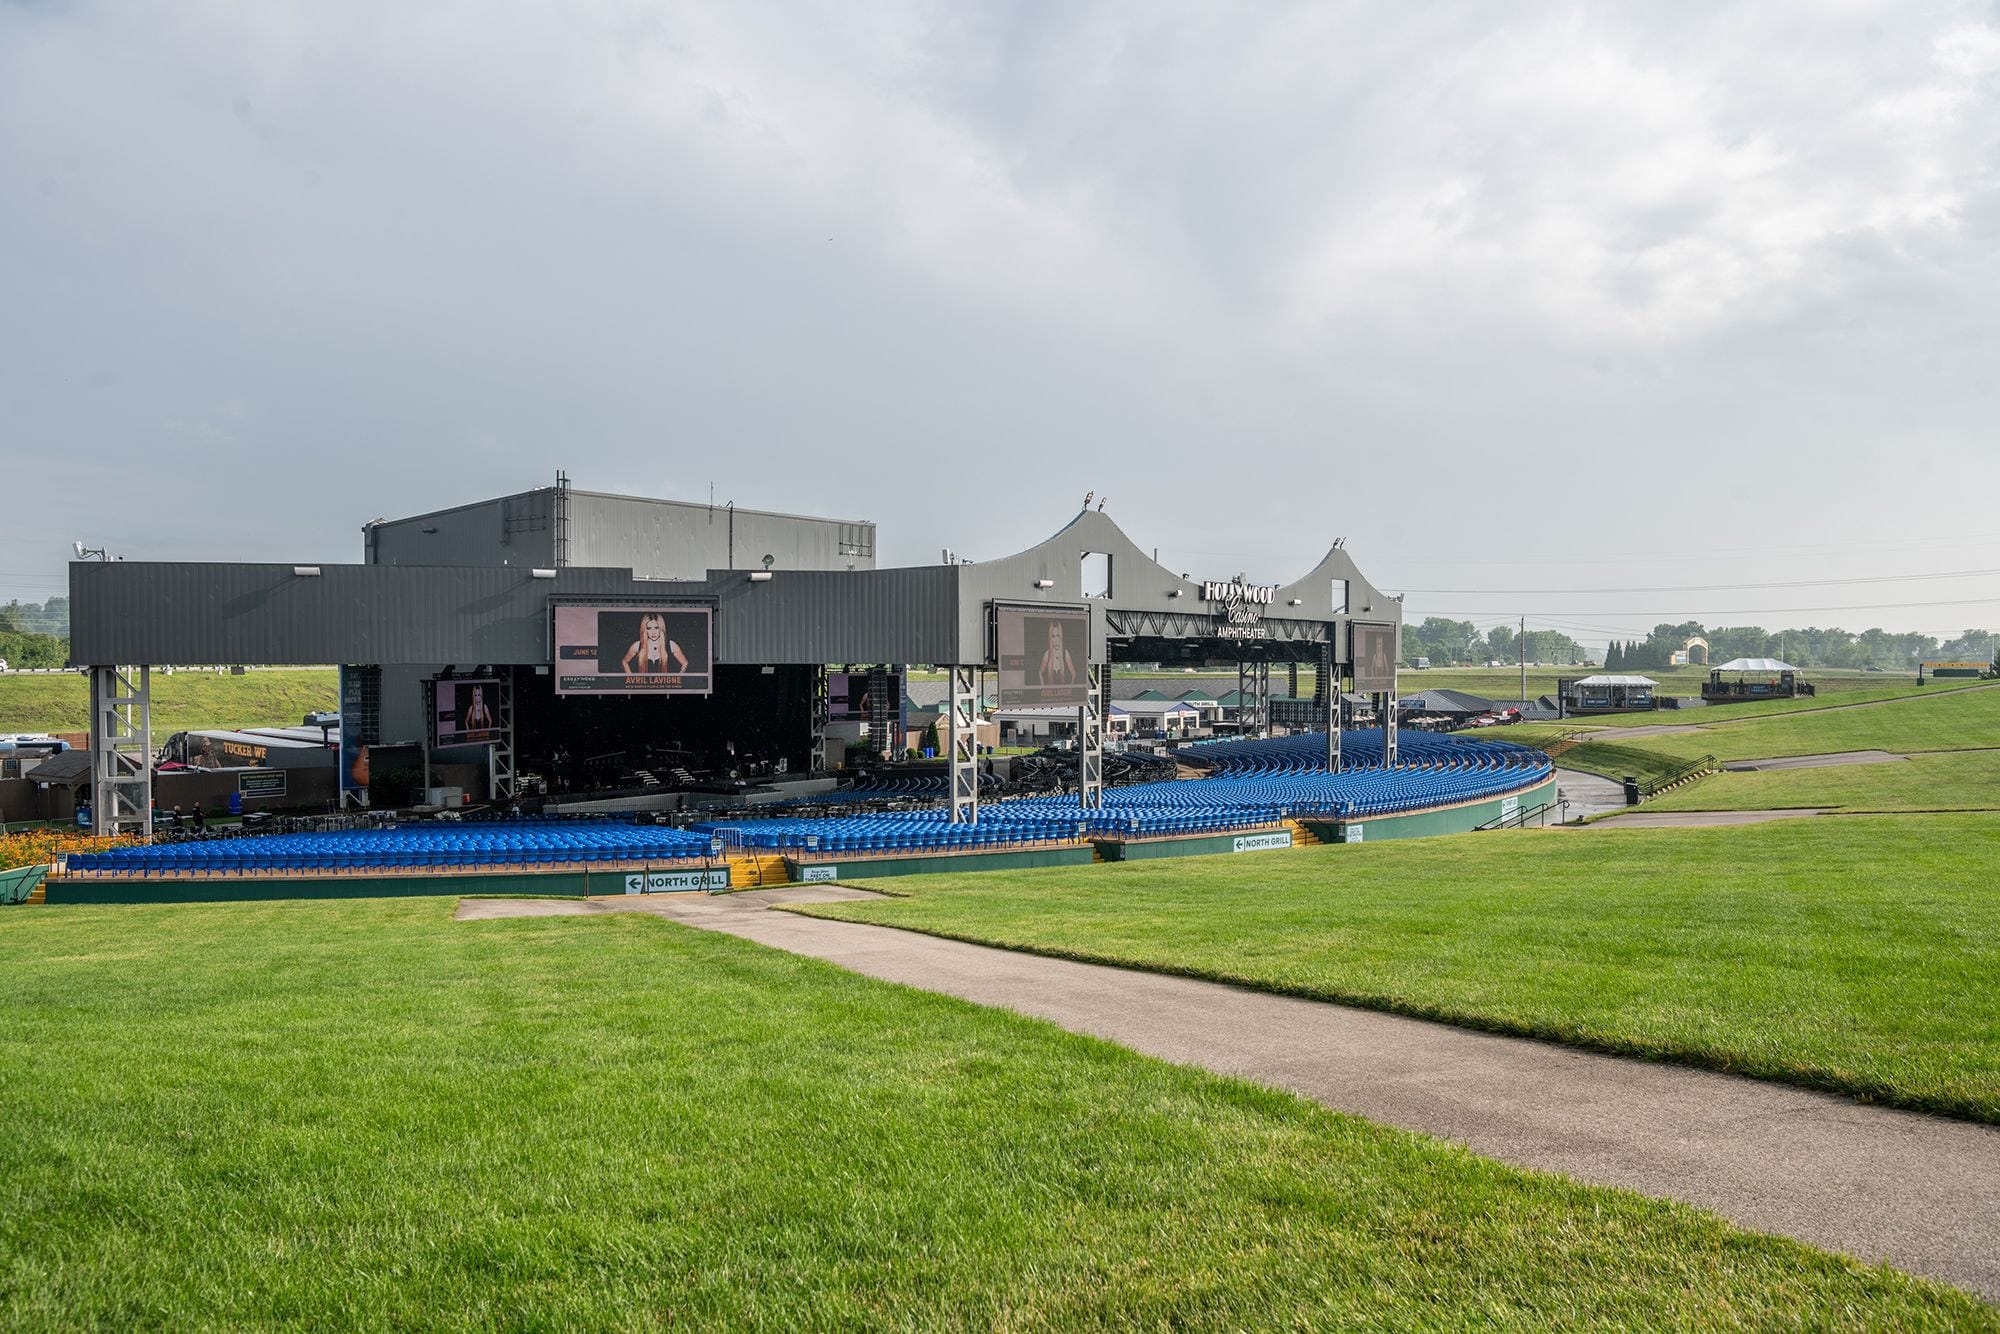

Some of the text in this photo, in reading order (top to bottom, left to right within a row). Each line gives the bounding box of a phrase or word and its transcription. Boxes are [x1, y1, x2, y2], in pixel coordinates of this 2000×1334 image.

[1205, 582, 1275, 604] HOLLYWOOD
[1225, 593, 1260, 624] Casino
[1217, 627, 1266, 639] AMPHITHEATER
[650, 676, 682, 684] LAVIGNE
[223, 741, 252, 757] TUCKER
[1245, 836, 1289, 848] NORTH GRILL
[648, 876, 688, 888] NORTH
